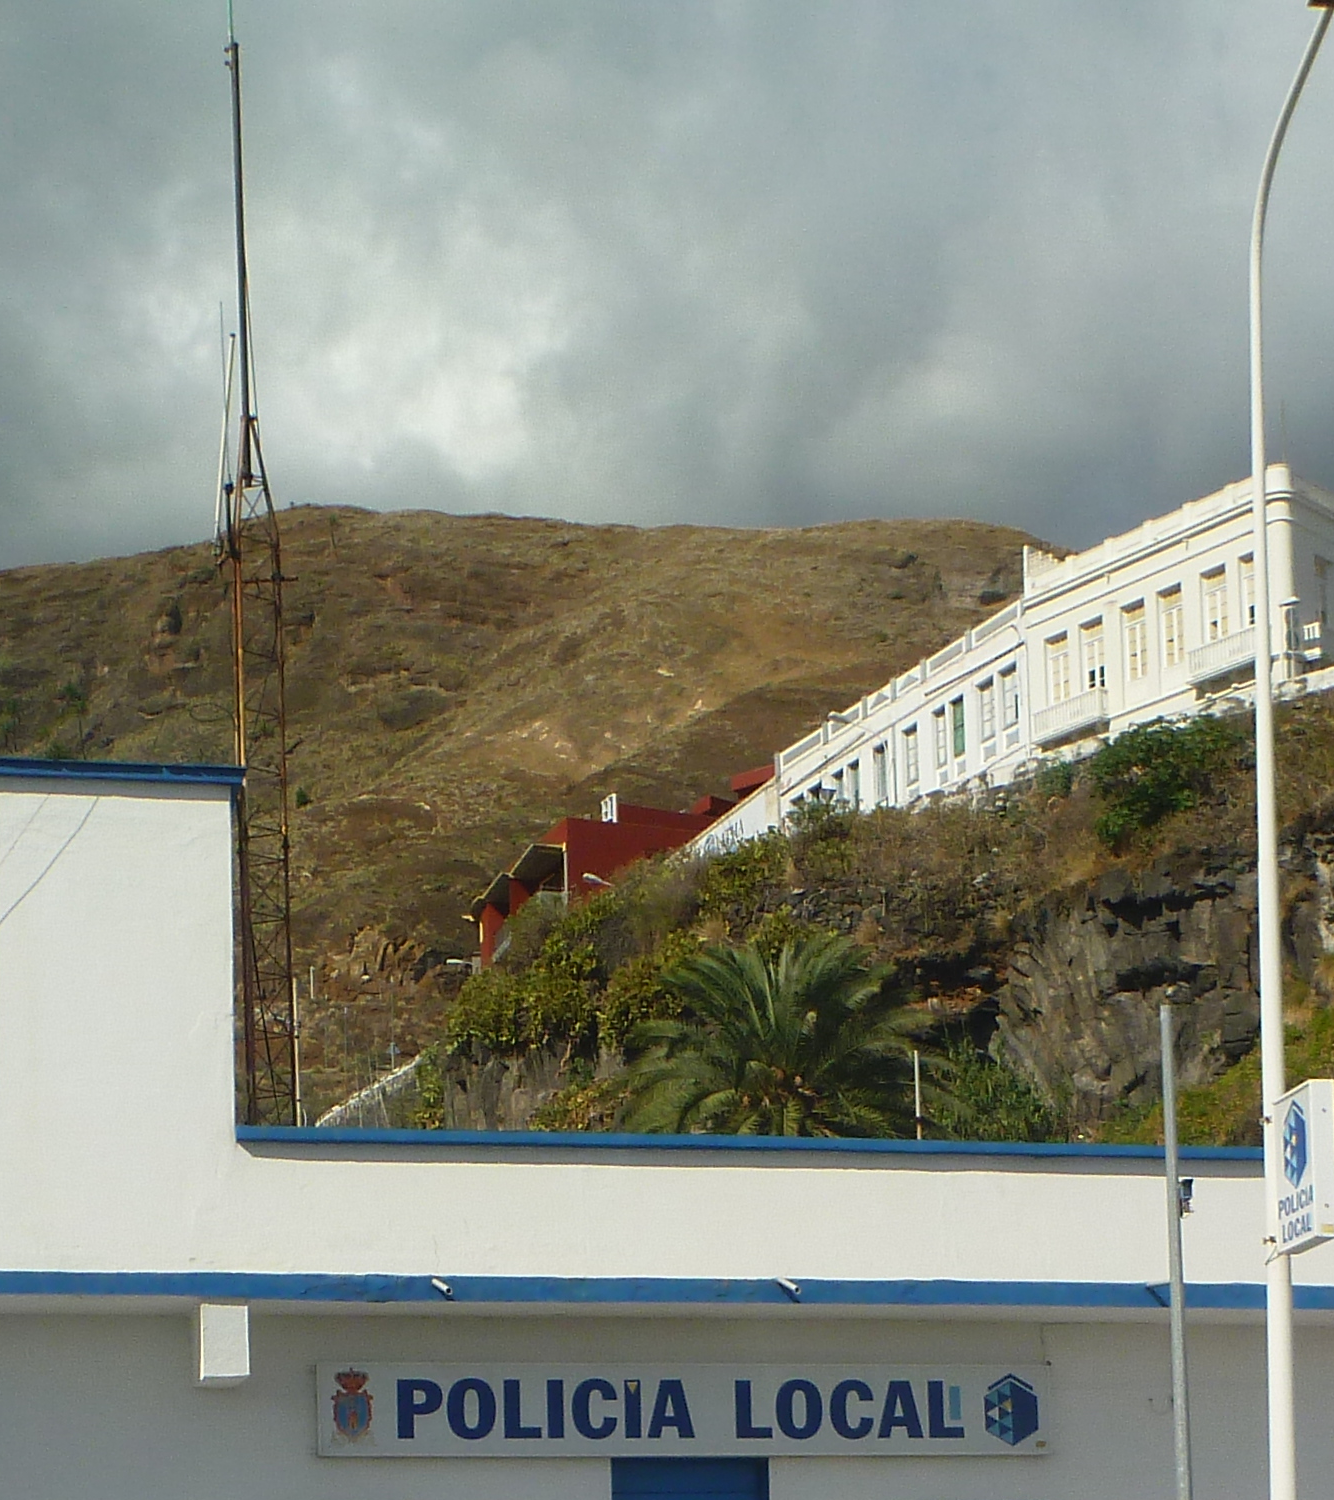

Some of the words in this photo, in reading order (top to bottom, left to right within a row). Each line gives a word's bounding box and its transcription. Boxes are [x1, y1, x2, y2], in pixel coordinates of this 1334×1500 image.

[1278, 1184, 1314, 1220] POLICIA
[1282, 1212, 1313, 1243] LOCAL
[735, 1378, 965, 1440] LOCAL
